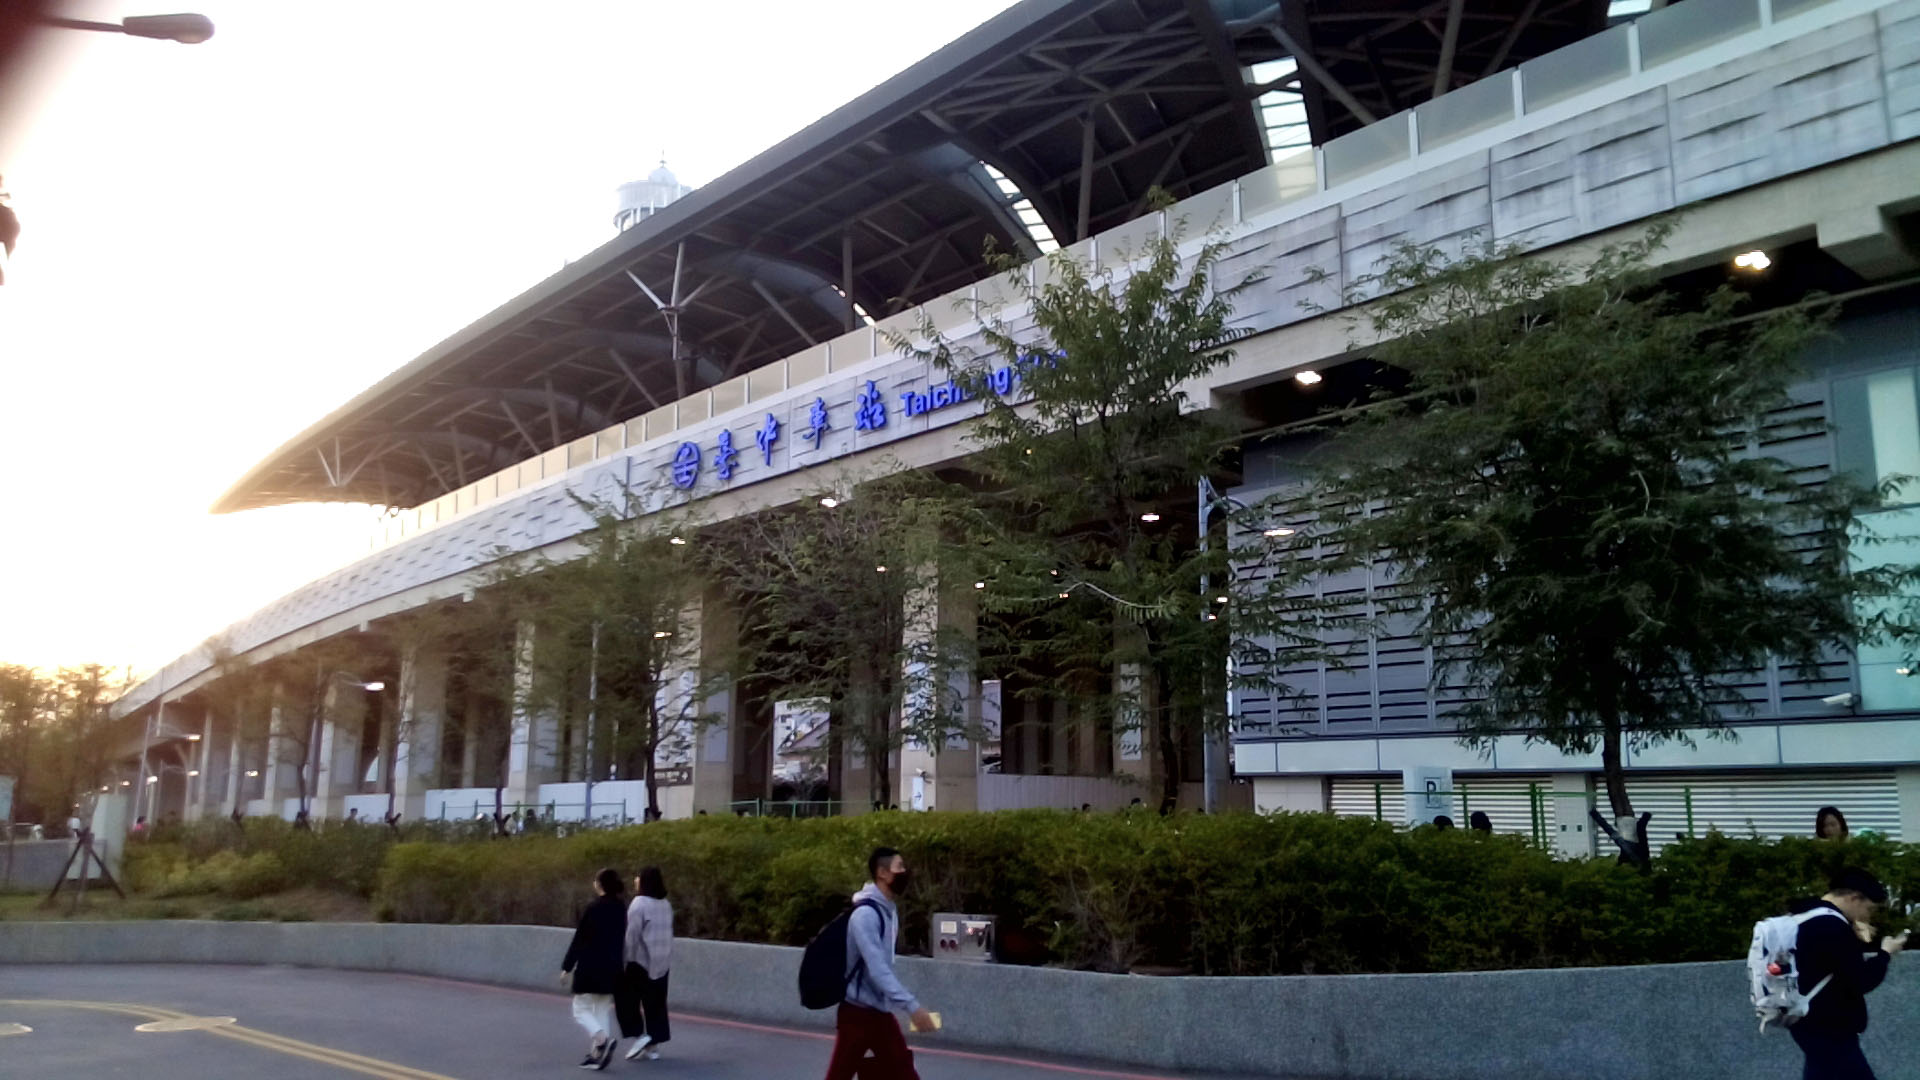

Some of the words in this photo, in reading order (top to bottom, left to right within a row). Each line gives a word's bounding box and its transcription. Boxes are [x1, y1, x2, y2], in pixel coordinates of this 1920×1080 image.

[714, 380, 888, 480] 臺中車站
[1426, 780, 1437, 804] P
